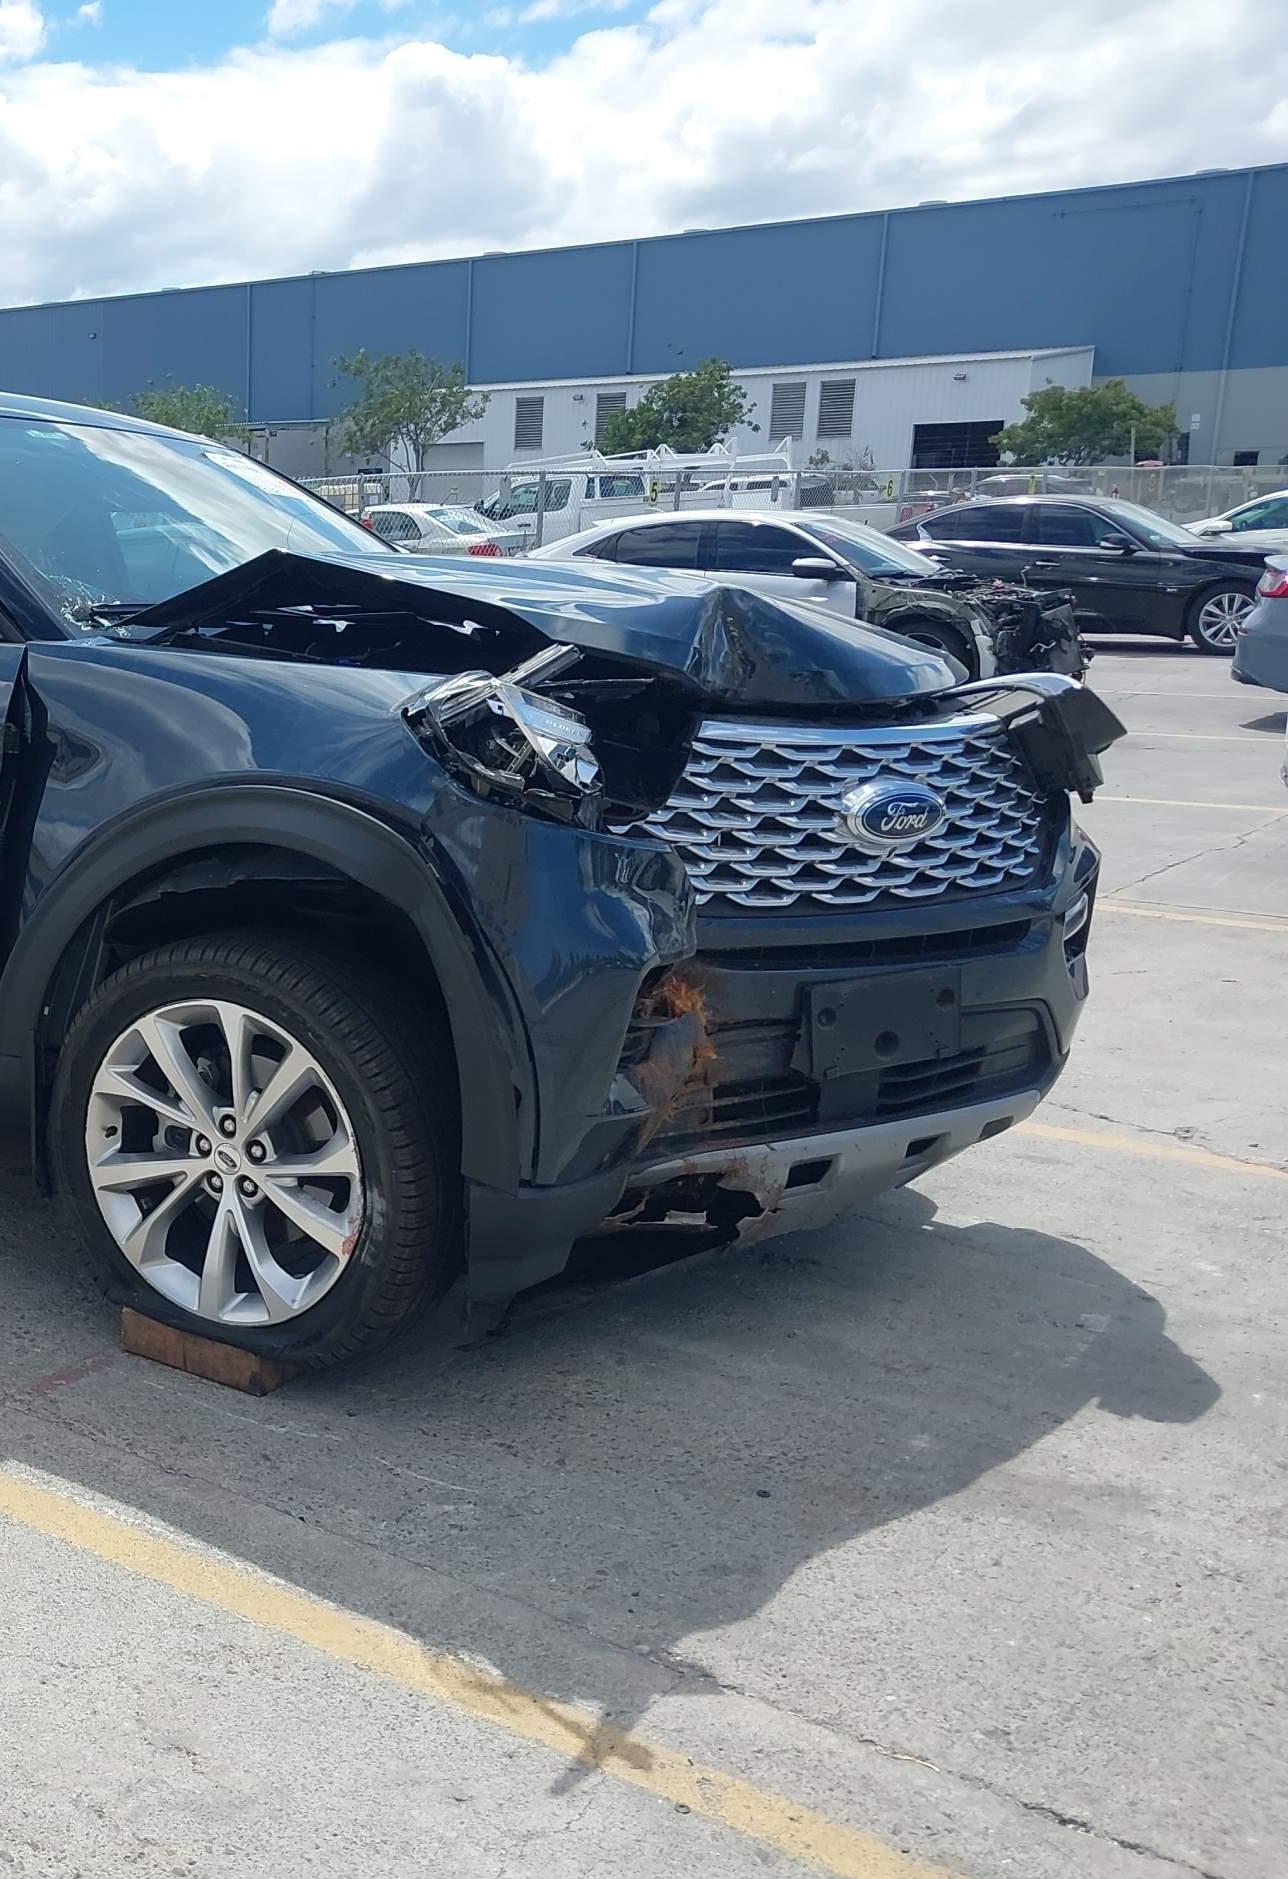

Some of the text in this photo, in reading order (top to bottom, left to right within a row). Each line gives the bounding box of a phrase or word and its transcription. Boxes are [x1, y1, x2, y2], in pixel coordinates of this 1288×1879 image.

[650, 481, 658, 502] 5
[887, 479, 894, 498] 6
[880, 801, 930, 831] Ford
